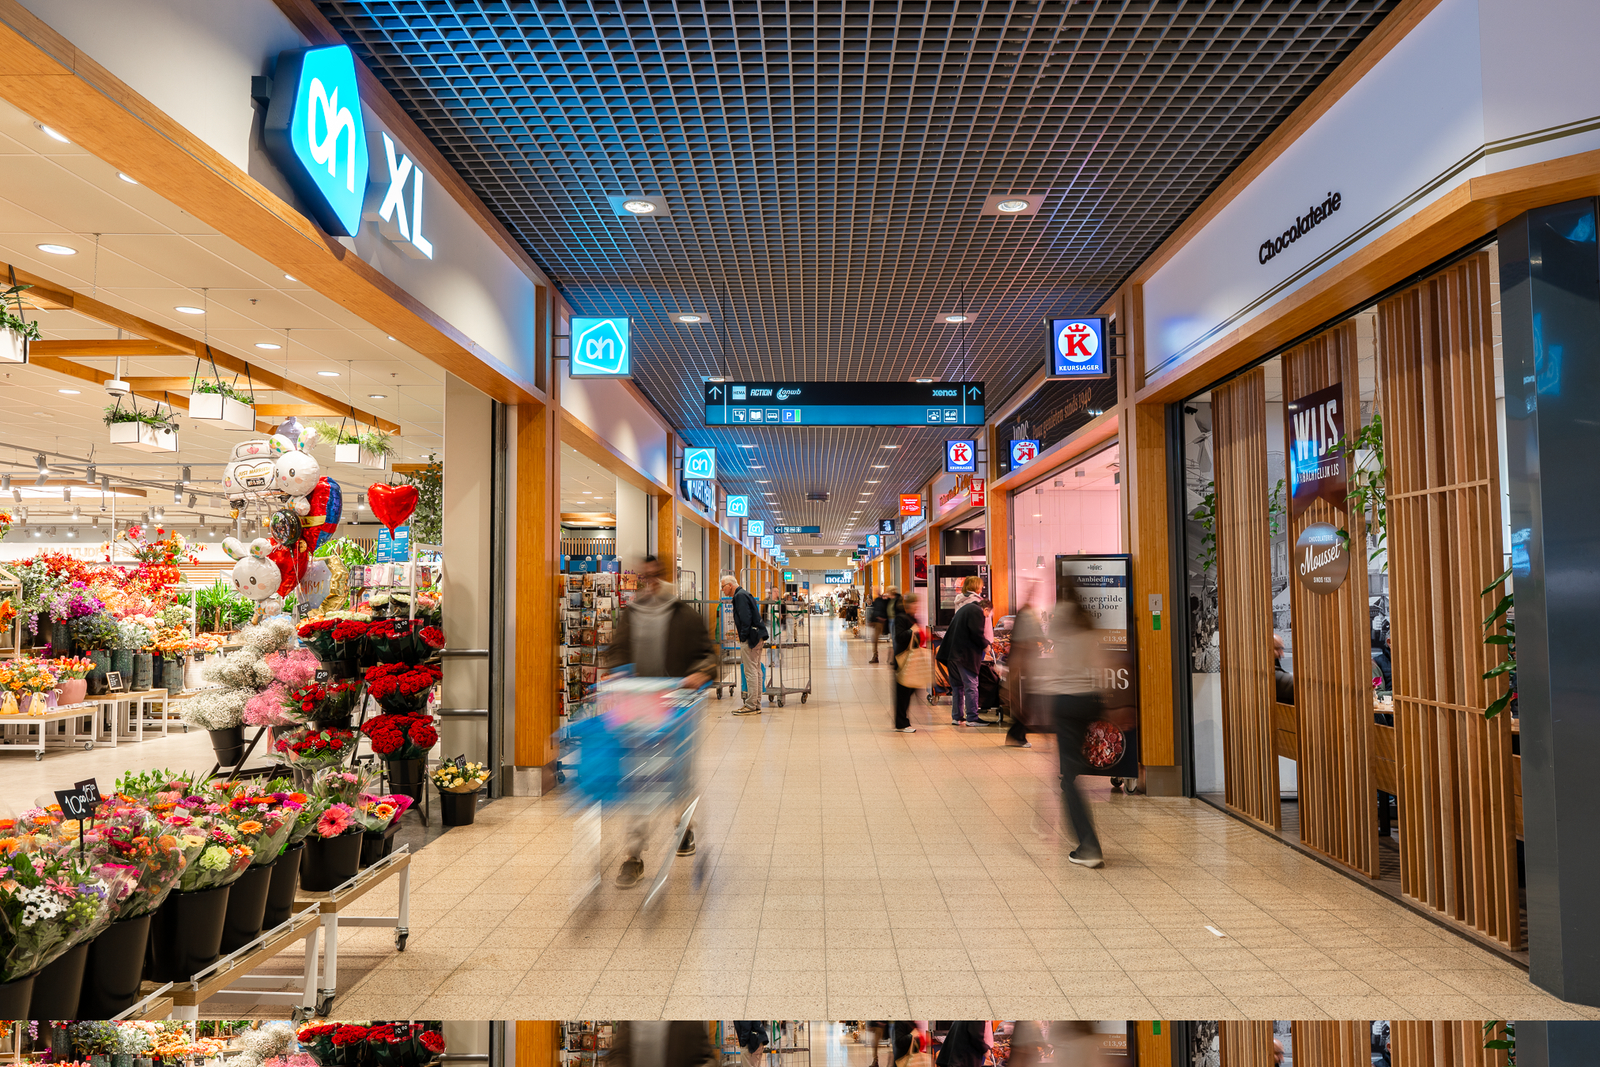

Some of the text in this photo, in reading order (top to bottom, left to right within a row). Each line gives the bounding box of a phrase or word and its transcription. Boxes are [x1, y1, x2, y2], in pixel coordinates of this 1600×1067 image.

[378, 131, 433, 260] XL
[1259, 191, 1341, 264] Chocolaterie
[1064, 333, 1092, 356] K
[932, 389, 958, 397] xenos
[1293, 399, 1338, 462] WIJS
[953, 448, 968, 462] K
[1331, 463, 1340, 476] IJS
[1308, 533, 1333, 543] CHOCOLATERIE
[1300, 537, 1341, 576] Mousset
[1089, 595, 1123, 603] gegrilde
